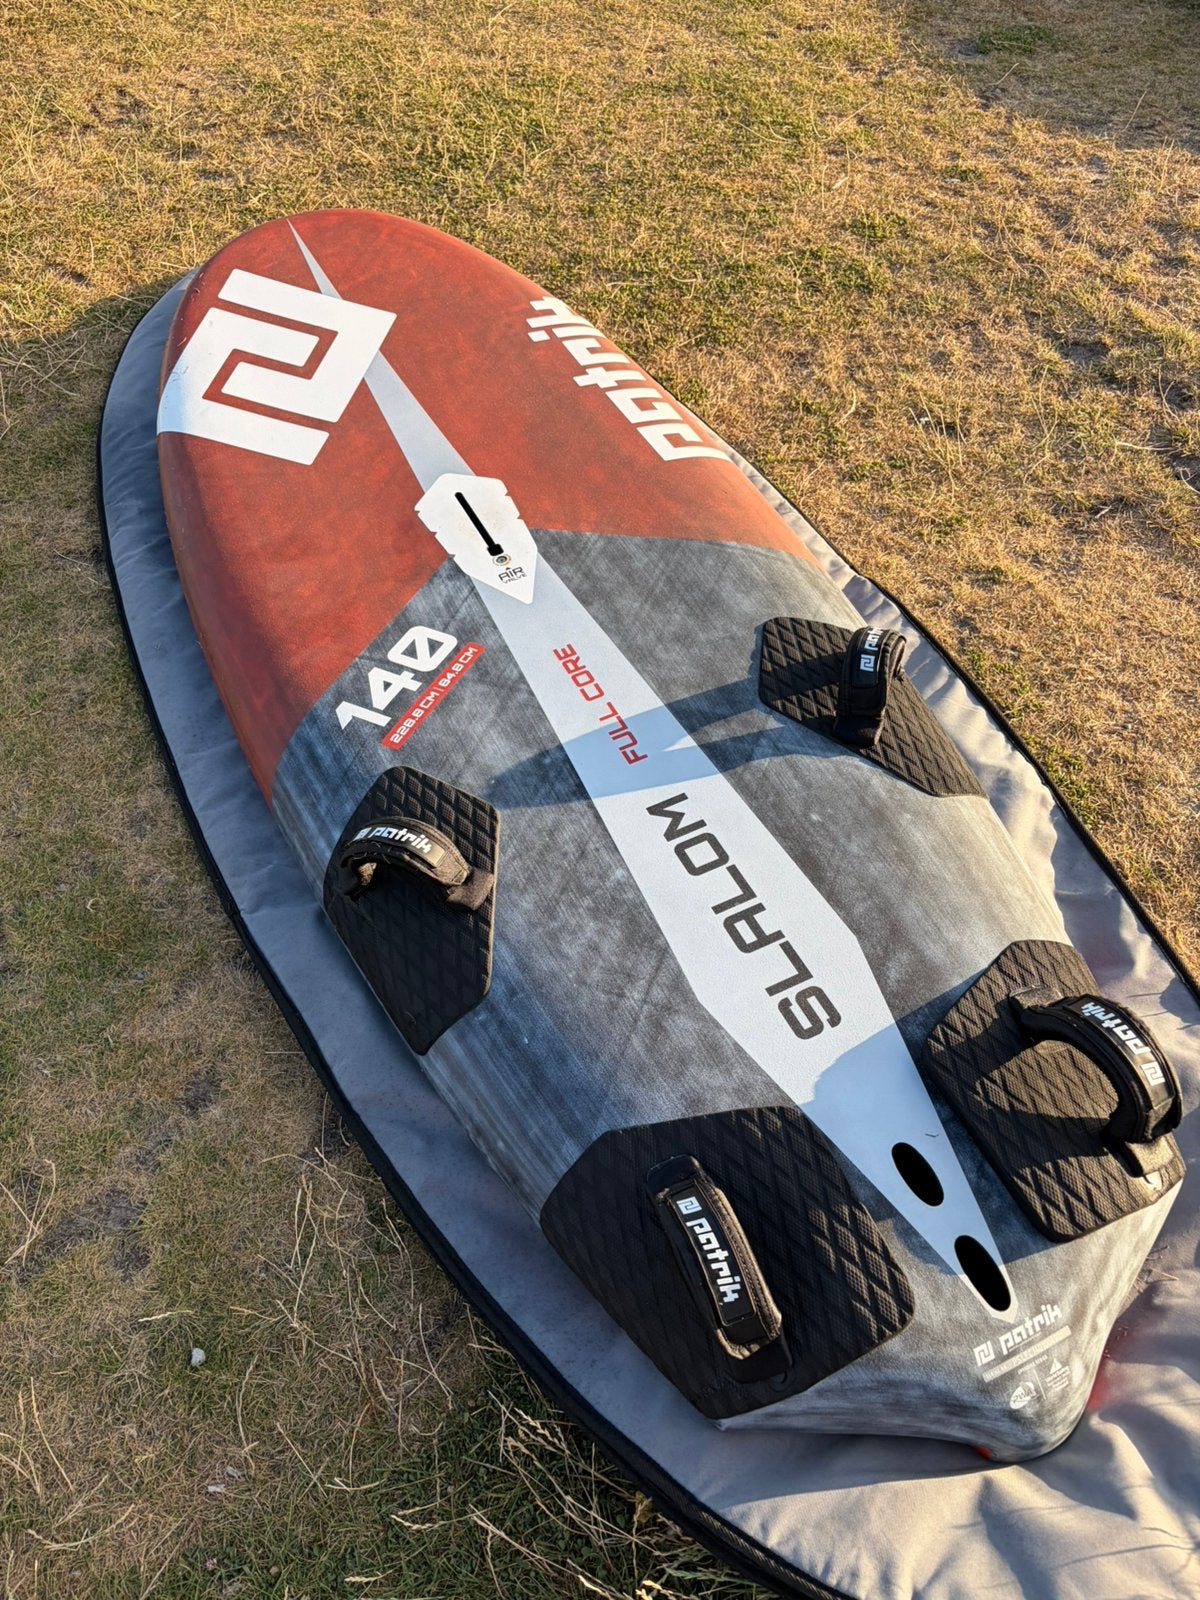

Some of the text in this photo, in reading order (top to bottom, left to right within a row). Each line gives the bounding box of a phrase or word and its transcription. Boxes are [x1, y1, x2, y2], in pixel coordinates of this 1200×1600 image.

[526, 296, 734, 462] patrik
[498, 567, 525, 581] AIR
[335, 625, 458, 730] 140
[389, 709, 425, 743] 228.8
[419, 690, 441, 709] CM
[438, 663, 464, 688] 84.8
[459, 647, 478, 665] CM
[552, 643, 649, 765] FULL CORE
[367, 826, 433, 854] patrik
[645, 792, 842, 1041] SLALOM
[1081, 1002, 1152, 1056] patrik
[685, 1217, 742, 1303] patrik
[998, 1303, 1063, 1356] patrik
